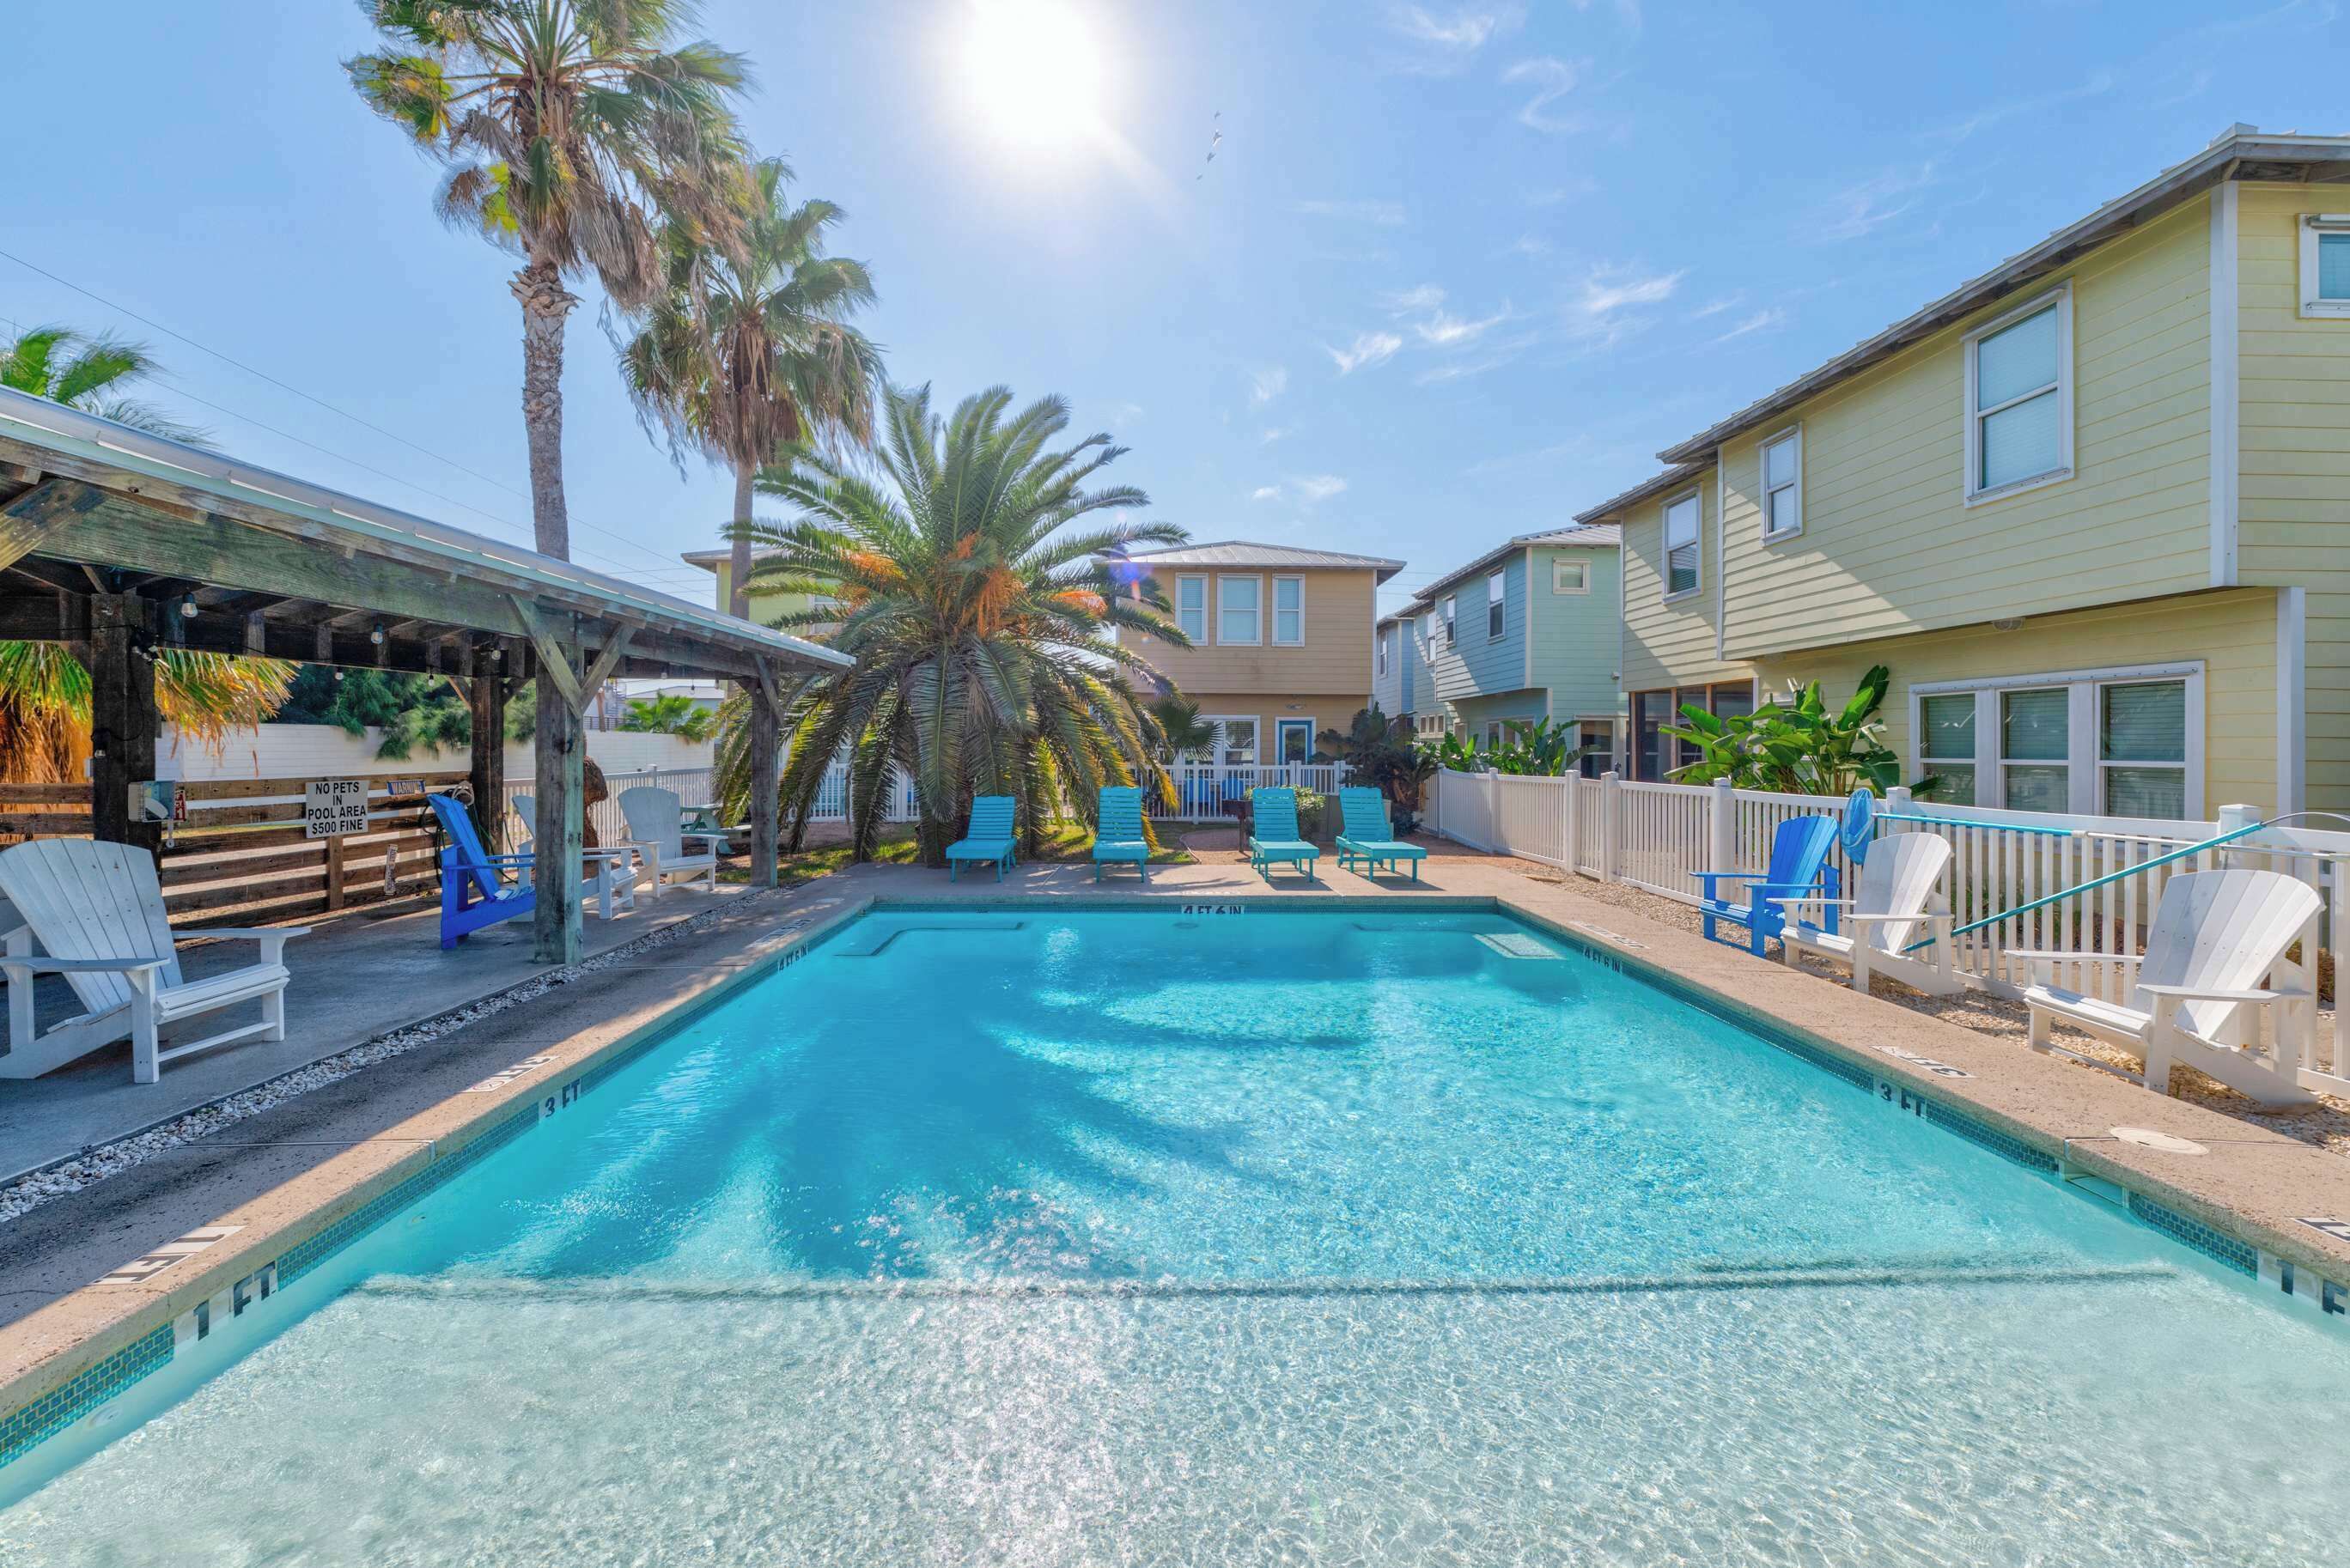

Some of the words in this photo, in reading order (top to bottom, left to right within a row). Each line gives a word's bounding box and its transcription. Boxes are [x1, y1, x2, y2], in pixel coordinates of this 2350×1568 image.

[315, 783, 330, 795] NO
[333, 781, 360, 793] PETS
[332, 794, 343, 805] IN
[308, 808, 336, 821] POOL
[338, 805, 367, 818] AREA
[340, 818, 363, 831] FINE
[1229, 905, 1242, 915] IN
[1930, 1067, 1968, 1076] 3
[545, 1097, 556, 1118] 3
[562, 1078, 581, 1109] FT
[1880, 1082, 1891, 1102] 3
[1901, 1087, 1926, 1117] FT
[193, 1298, 210, 1341] 1
